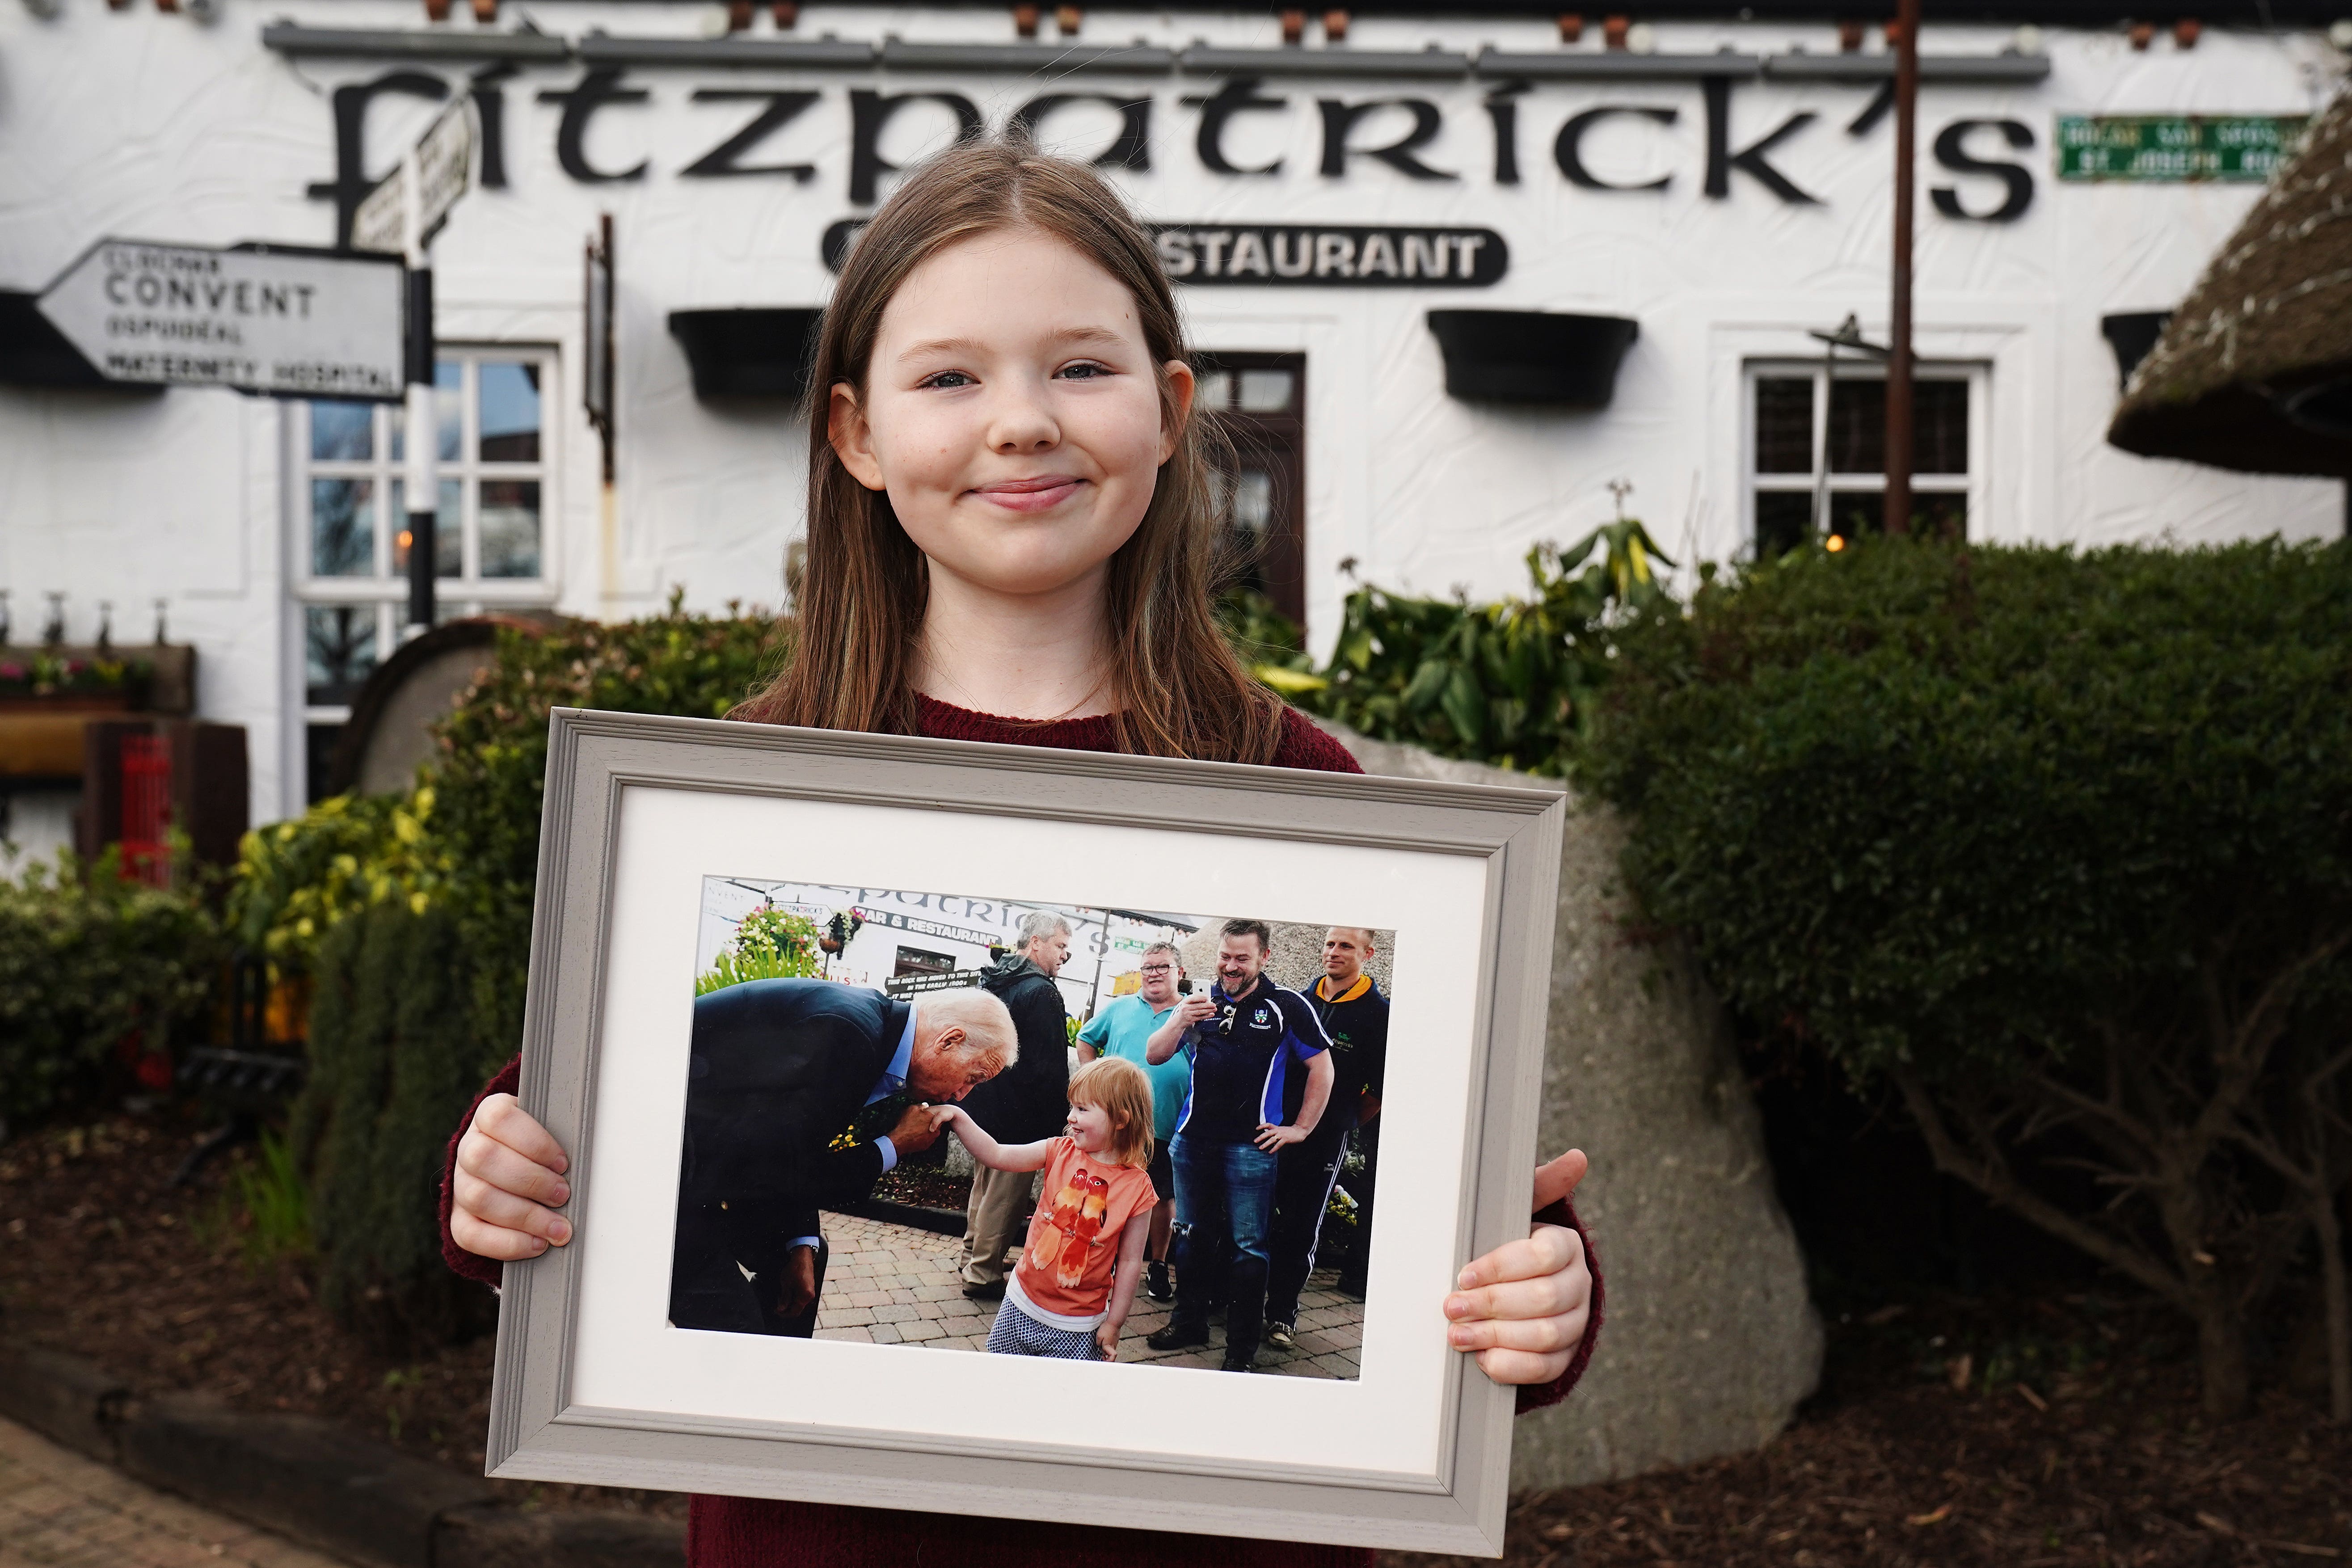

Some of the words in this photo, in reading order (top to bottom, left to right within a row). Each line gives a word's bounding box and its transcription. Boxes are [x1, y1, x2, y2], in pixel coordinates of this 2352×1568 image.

[1161, 231, 1487, 279] STAURANT
[105, 271, 315, 318] CONVENT
[106, 351, 257, 378] MATERNITY
[274, 360, 393, 392] HOSPITAL
[906, 918, 999, 946] RESTAURANT
